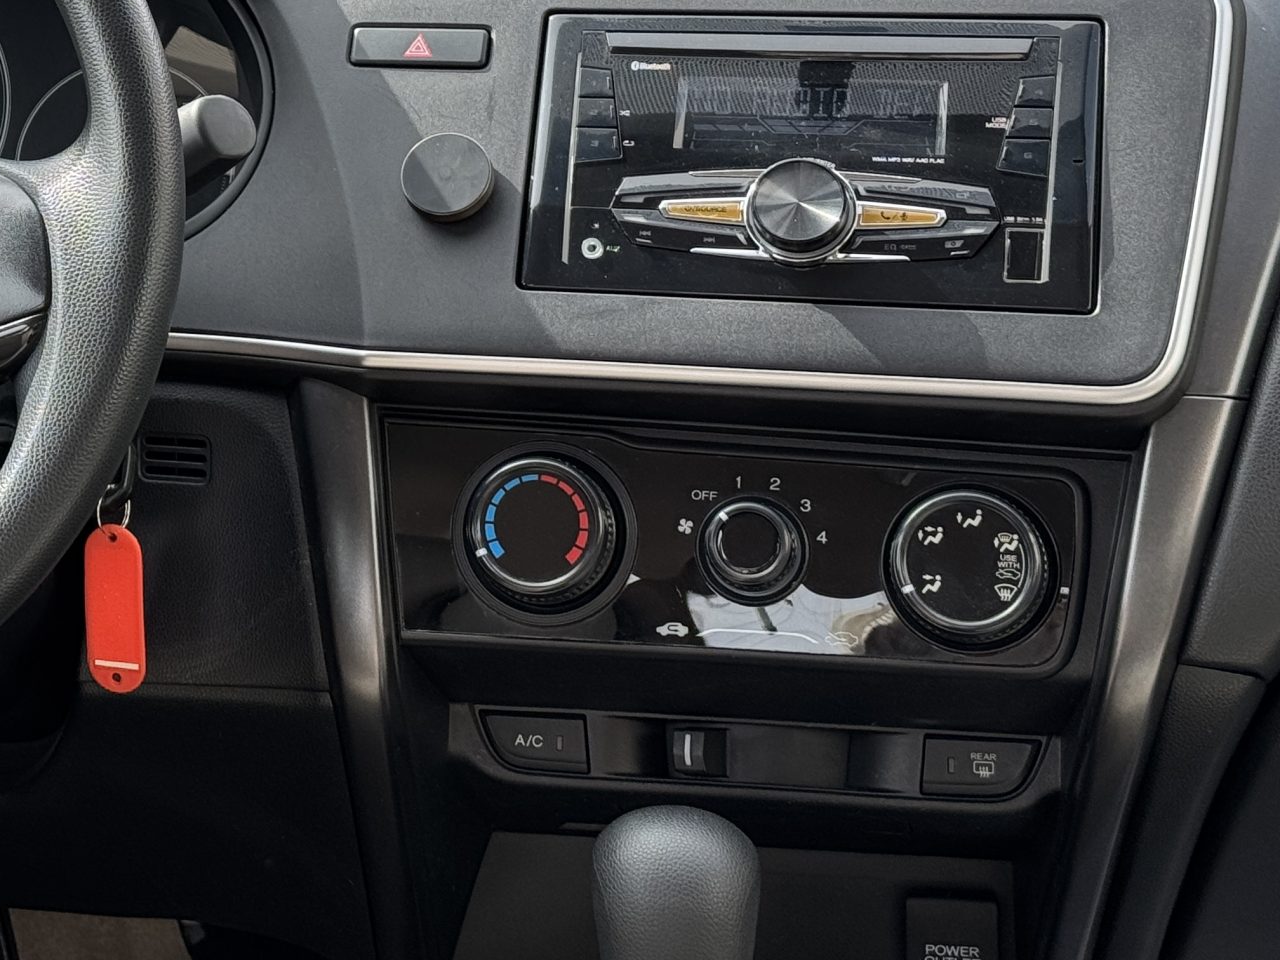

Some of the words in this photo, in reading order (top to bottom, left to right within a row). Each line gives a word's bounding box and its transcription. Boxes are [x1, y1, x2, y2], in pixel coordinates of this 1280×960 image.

[736, 475, 742, 489] 1
[769, 477, 781, 490] 2
[691, 489, 719, 501] OFF
[799, 498, 812, 513] 3
[816, 530, 828, 544] 4
[999, 553, 1018, 562] USE
[997, 561, 1021, 569] WITH
[514, 733, 544, 748] A/C
[970, 752, 997, 761] REAR
[925, 944, 980, 958] POWER
